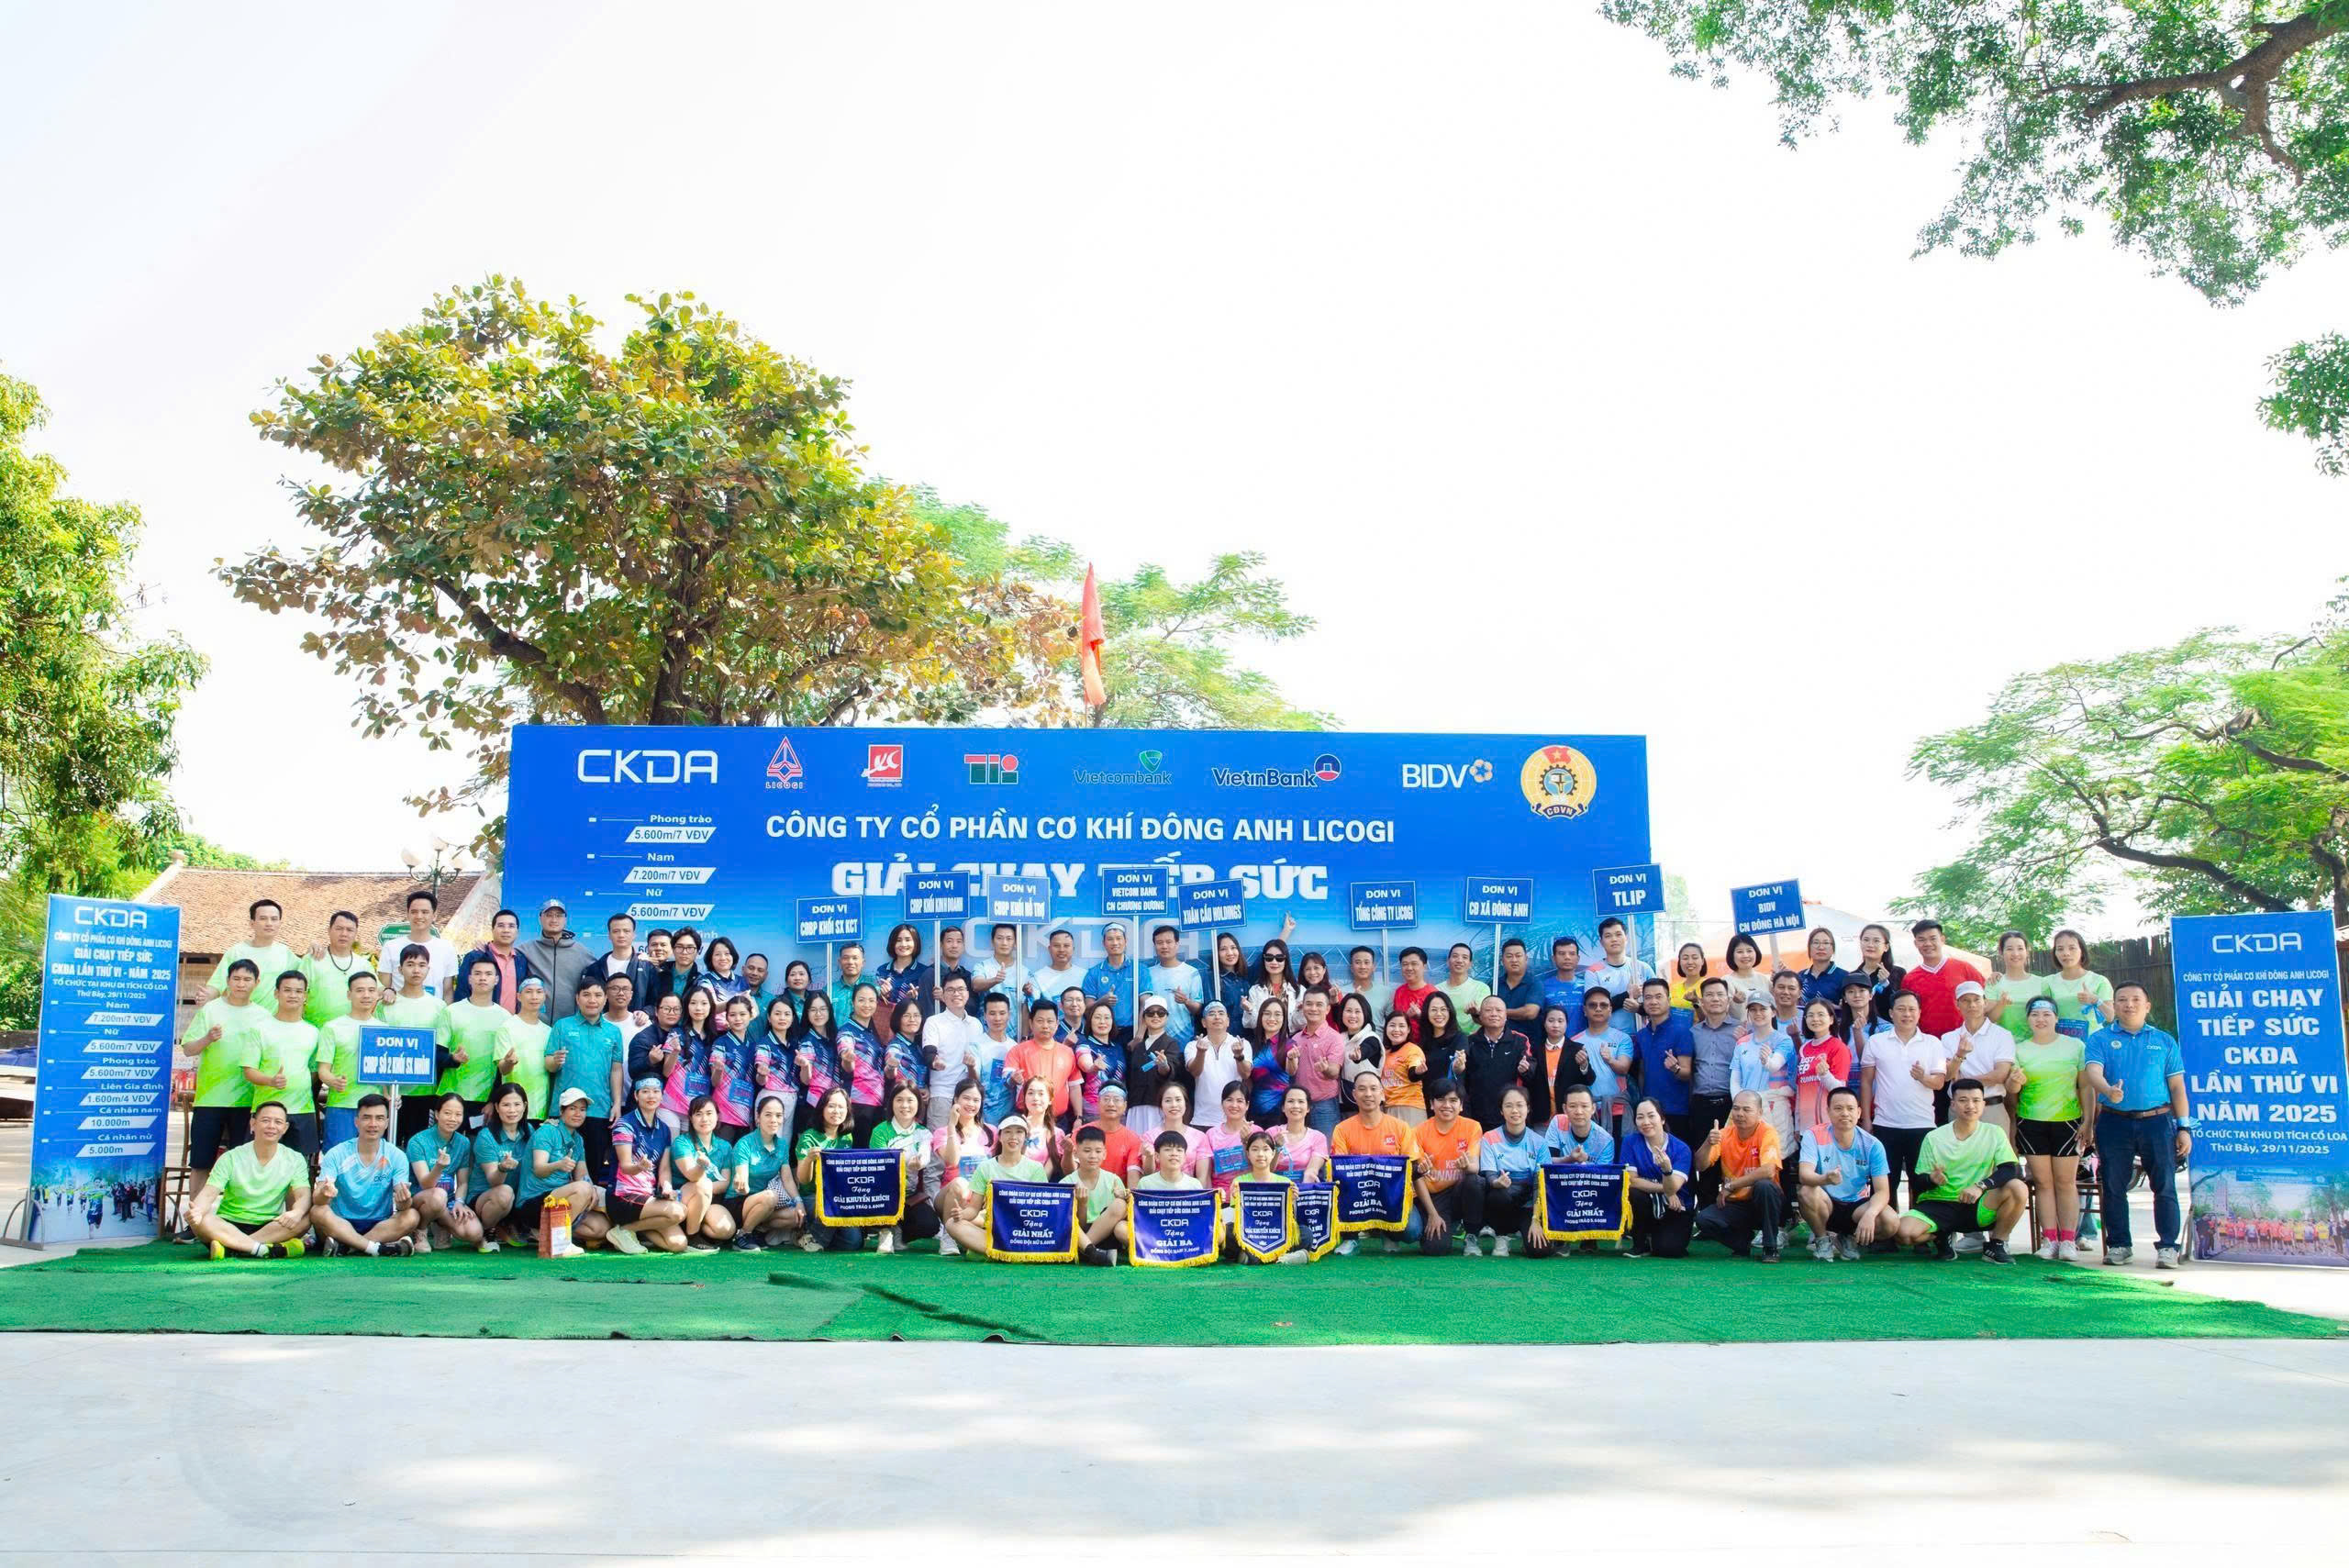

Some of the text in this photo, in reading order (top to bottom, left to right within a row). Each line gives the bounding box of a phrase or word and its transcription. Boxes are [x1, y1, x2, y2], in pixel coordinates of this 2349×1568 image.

[577, 750, 718, 783] CKDA
[1074, 769, 1172, 784] Vietcombank
[1211, 767, 1318, 787] VietinBank
[1402, 763, 1469, 788] BIDV
[1546, 805, 1574, 817] CĐVN
[651, 816, 686, 824] Phong
[766, 804, 1394, 842] CÔNG TY CỔ PHẦN CƠ KHÍ ĐÔNG ANH LICOGI
[635, 830, 708, 840] 5.600m/7 VĐV
[647, 853, 674, 862] Nam
[633, 871, 700, 880] 7.200m/7 VĐV
[1118, 874, 1140, 883] ĐƠN
[1609, 873, 1646, 884] ĐƠN VỊ
[943, 881, 953, 889] VỊ
[1003, 884, 1024, 893] ĐƠN
[1483, 885, 1505, 894] ĐƠN
[1112, 887, 1157, 897] VIETCOM BANK
[1194, 890, 1215, 900] ĐƠN
[1366, 890, 1387, 898] ĐƠN
[1749, 886, 1782, 898] ĐƠN VỊ
[1612, 890, 1646, 907] TLIP
[812, 905, 834, 914] ĐƠN
[1107, 901, 1116, 910] CN
[1513, 903, 1528, 917] ANH
[1758, 902, 1776, 913] BIDV
[75, 906, 147, 929] CKDA
[631, 907, 706, 917] 5.600m/7 VĐV
[1387, 906, 1394, 920] TY
[1396, 906, 1413, 920] LICOGI
[836, 919, 844, 934] SX
[845, 919, 857, 933] KCT
[1739, 922, 1750, 932] CN
[1774, 916, 1784, 928] HÀ
[1786, 914, 1799, 927] NỘI
[2212, 932, 2301, 953] CKDA
[151, 969, 172, 980] 2025
[2184, 971, 2201, 982] CÔNG
[2290, 971, 2304, 979] ANH
[2306, 970, 2329, 979] LICOGI
[2190, 984, 2323, 1011] GIẢI CHẠY
[2199, 1013, 2320, 1037] TIẾP SỨC
[91, 1042, 132, 1051] 5.600m/7
[376, 1037, 418, 1050] ĐƠN VỊ
[2224, 1047, 2299, 1064] CKĐA
[90, 1069, 131, 1077] 5.600m/7
[2191, 1070, 2338, 1094] LẦN THỨ VI
[2197, 1101, 2337, 1123] NĂM 2025
[2206, 1129, 2232, 1138] CHỨC
[2251, 1131, 2272, 1140] KHU
[2274, 1131, 2284, 1140] DI
[2287, 1130, 2310, 1140] TÍCH
[2328, 1132, 2348, 1141] LOA
[2210, 1143, 2232, 1152] Thứ
[2262, 1145, 2329, 1153] 29/11/2025
[1012, 1229, 1053, 1238] GIẢI NHẤT
